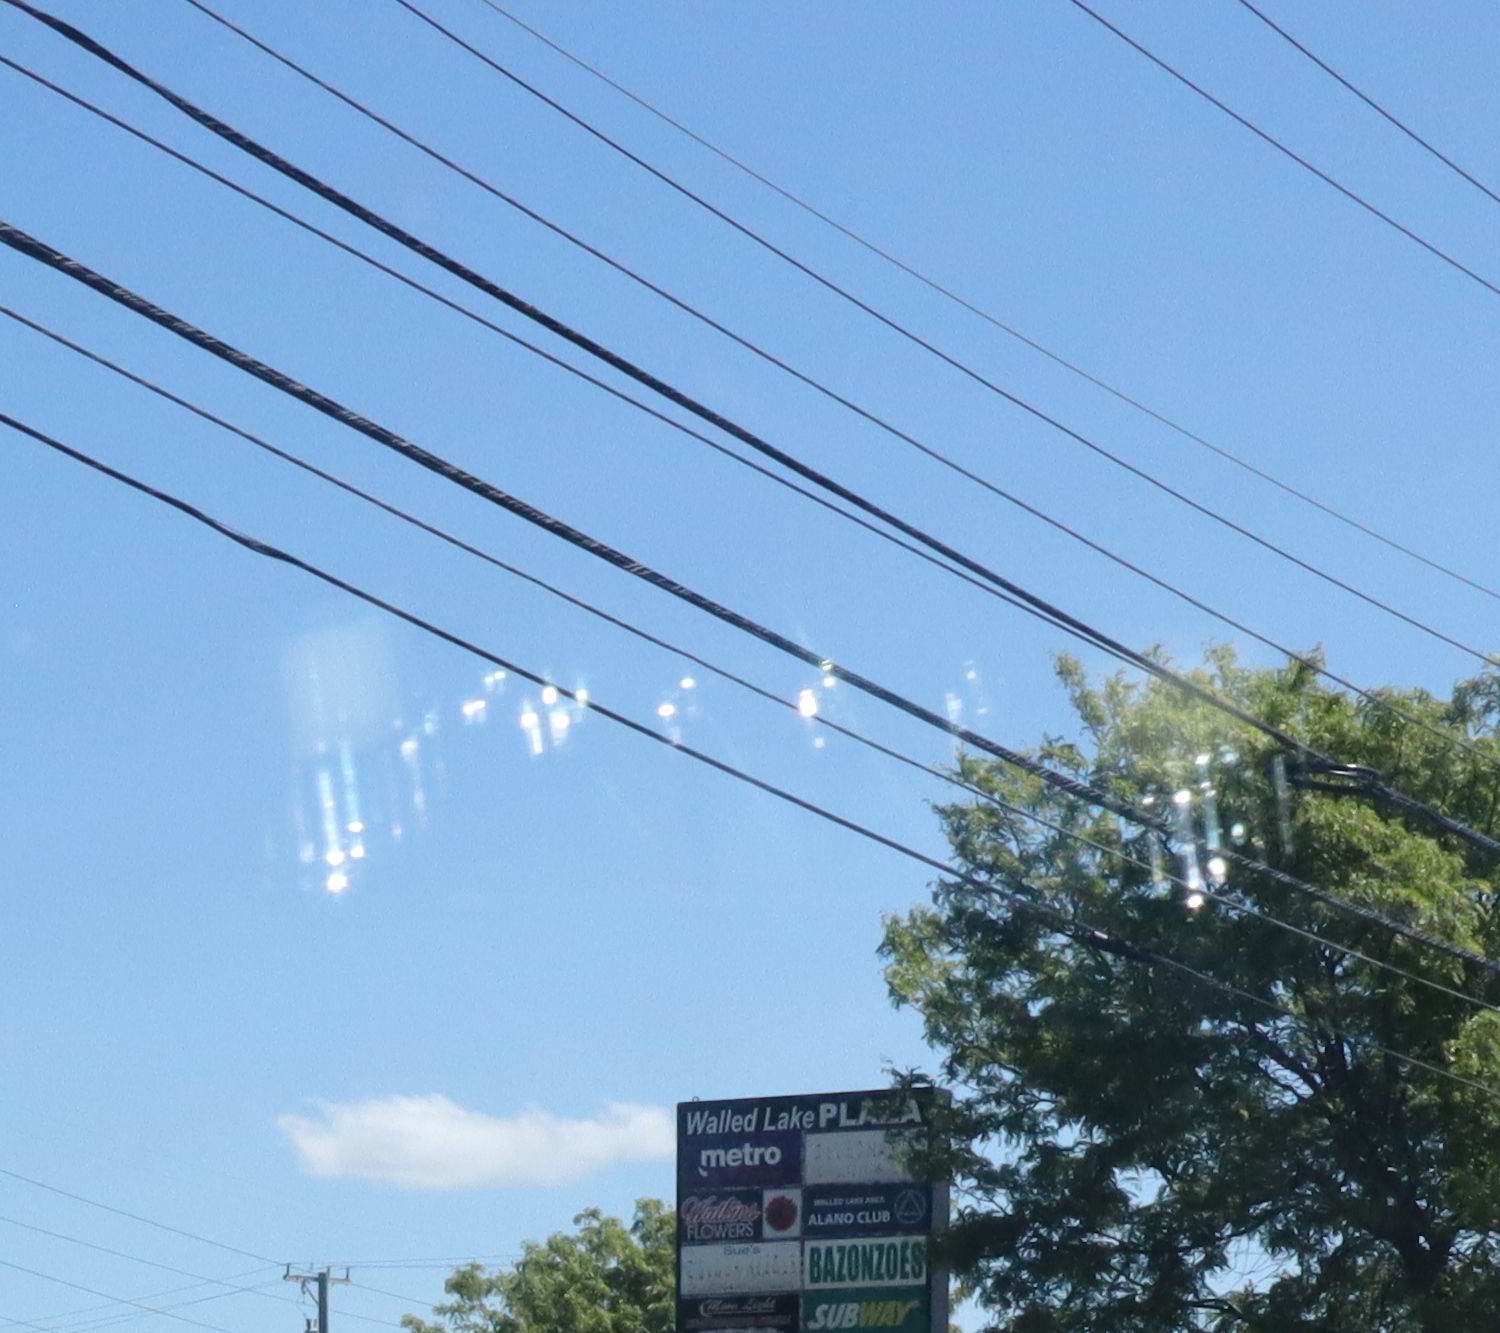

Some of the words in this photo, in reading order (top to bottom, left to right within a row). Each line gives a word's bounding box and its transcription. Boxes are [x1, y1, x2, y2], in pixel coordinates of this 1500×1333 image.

[685, 1107, 759, 1135] Walled
[763, 1105, 815, 1131] Lake
[819, 1099, 922, 1128] PLAA
[700, 1143, 782, 1175] metro
[687, 1222, 754, 1239] FLOWERS
[808, 1212, 855, 1226] ALANO
[857, 1210, 891, 1224] CLUB
[810, 1241, 924, 1283] BAZONZOES
[806, 1300, 920, 1330] SUBWAY
